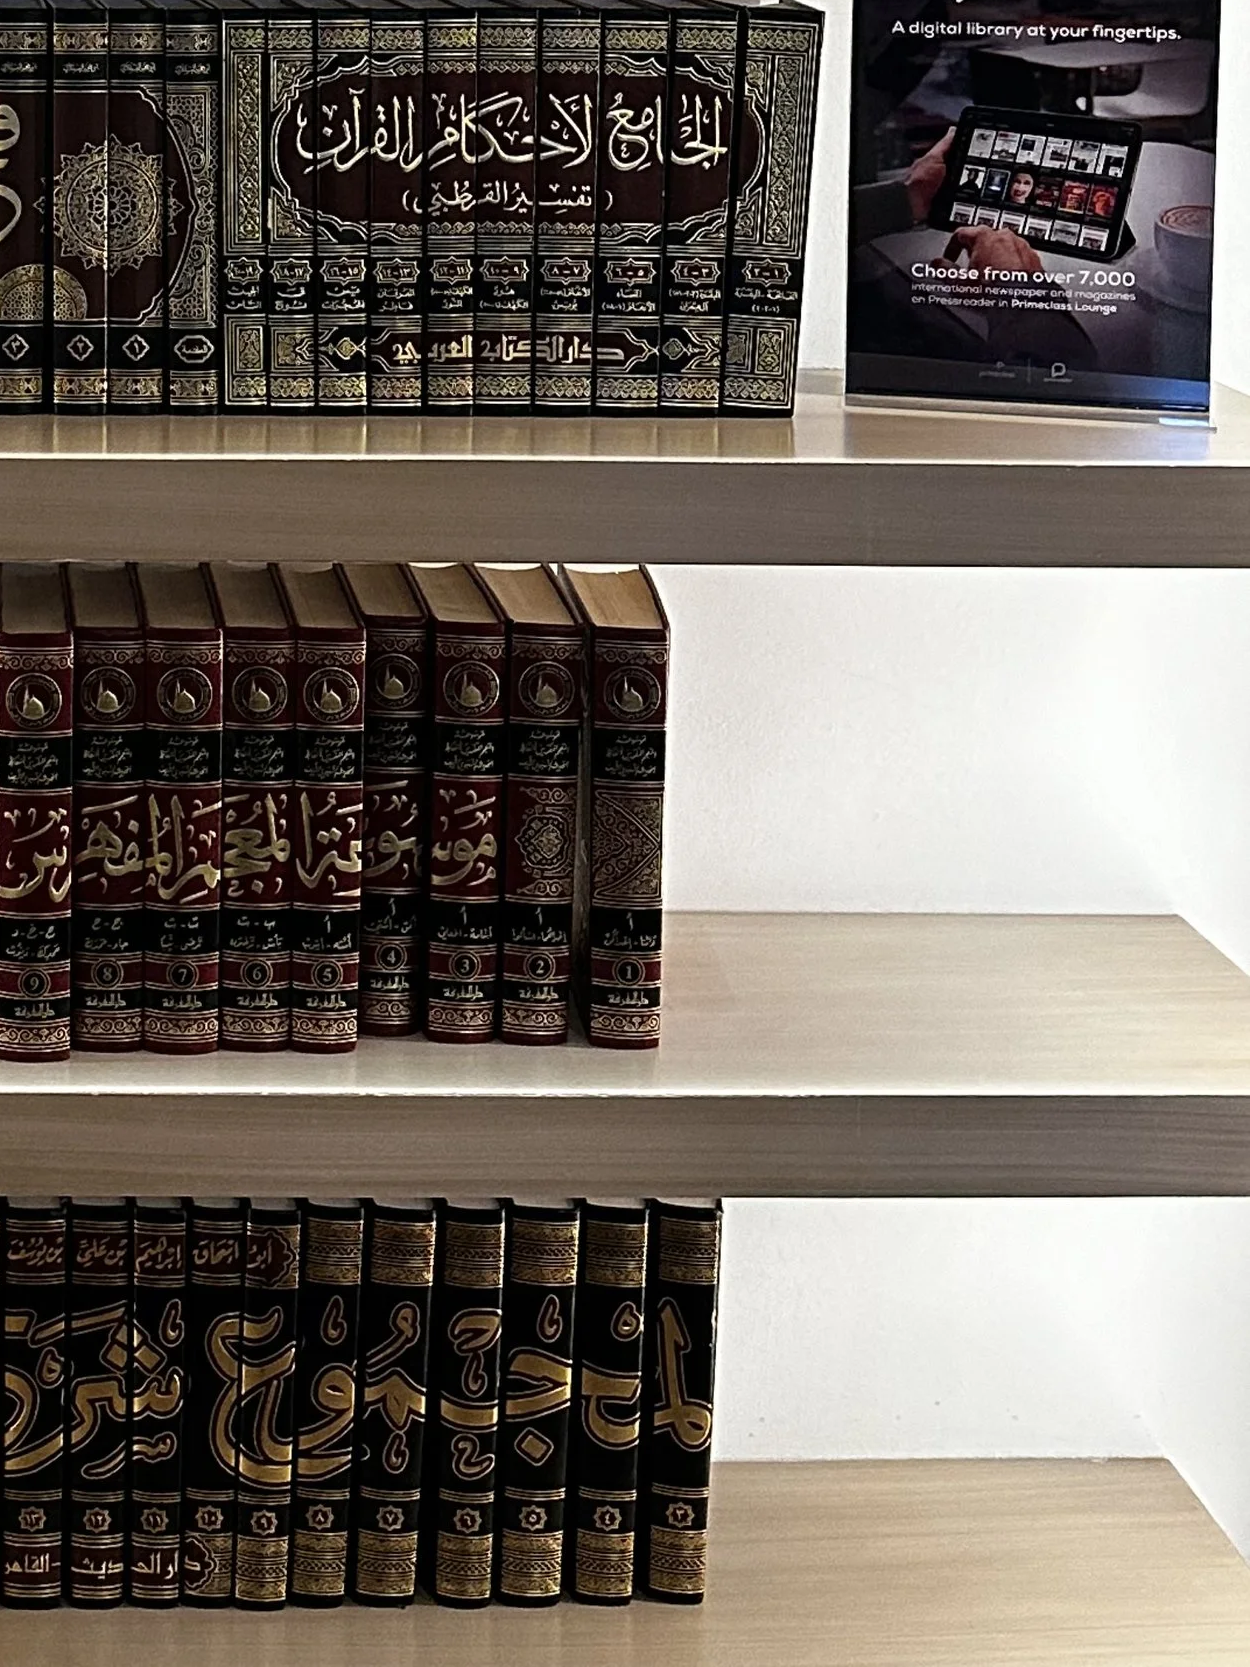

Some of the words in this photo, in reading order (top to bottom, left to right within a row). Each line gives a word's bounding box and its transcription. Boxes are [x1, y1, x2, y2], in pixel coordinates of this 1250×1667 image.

[891, 20, 905, 34] A
[908, 21, 962, 38] digital
[966, 22, 1024, 39] library
[1027, 25, 1046, 37] at
[1049, 26, 1089, 40] your
[1092, 24, 1182, 43] fingertips.
[911, 263, 980, 280] Choose
[984, 266, 1028, 282] from
[1032, 271, 1075, 284] over
[1079, 270, 1136, 287] 7,000
[985, 286, 1048, 298] newspaper
[1050, 288, 1072, 299] and
[1074, 290, 1137, 302] magazines
[911, 297, 926, 305] on
[998, 299, 1009, 308] in
[1011, 299, 1073, 312] Primeclass
[1074, 303, 1118, 315] Lounge
